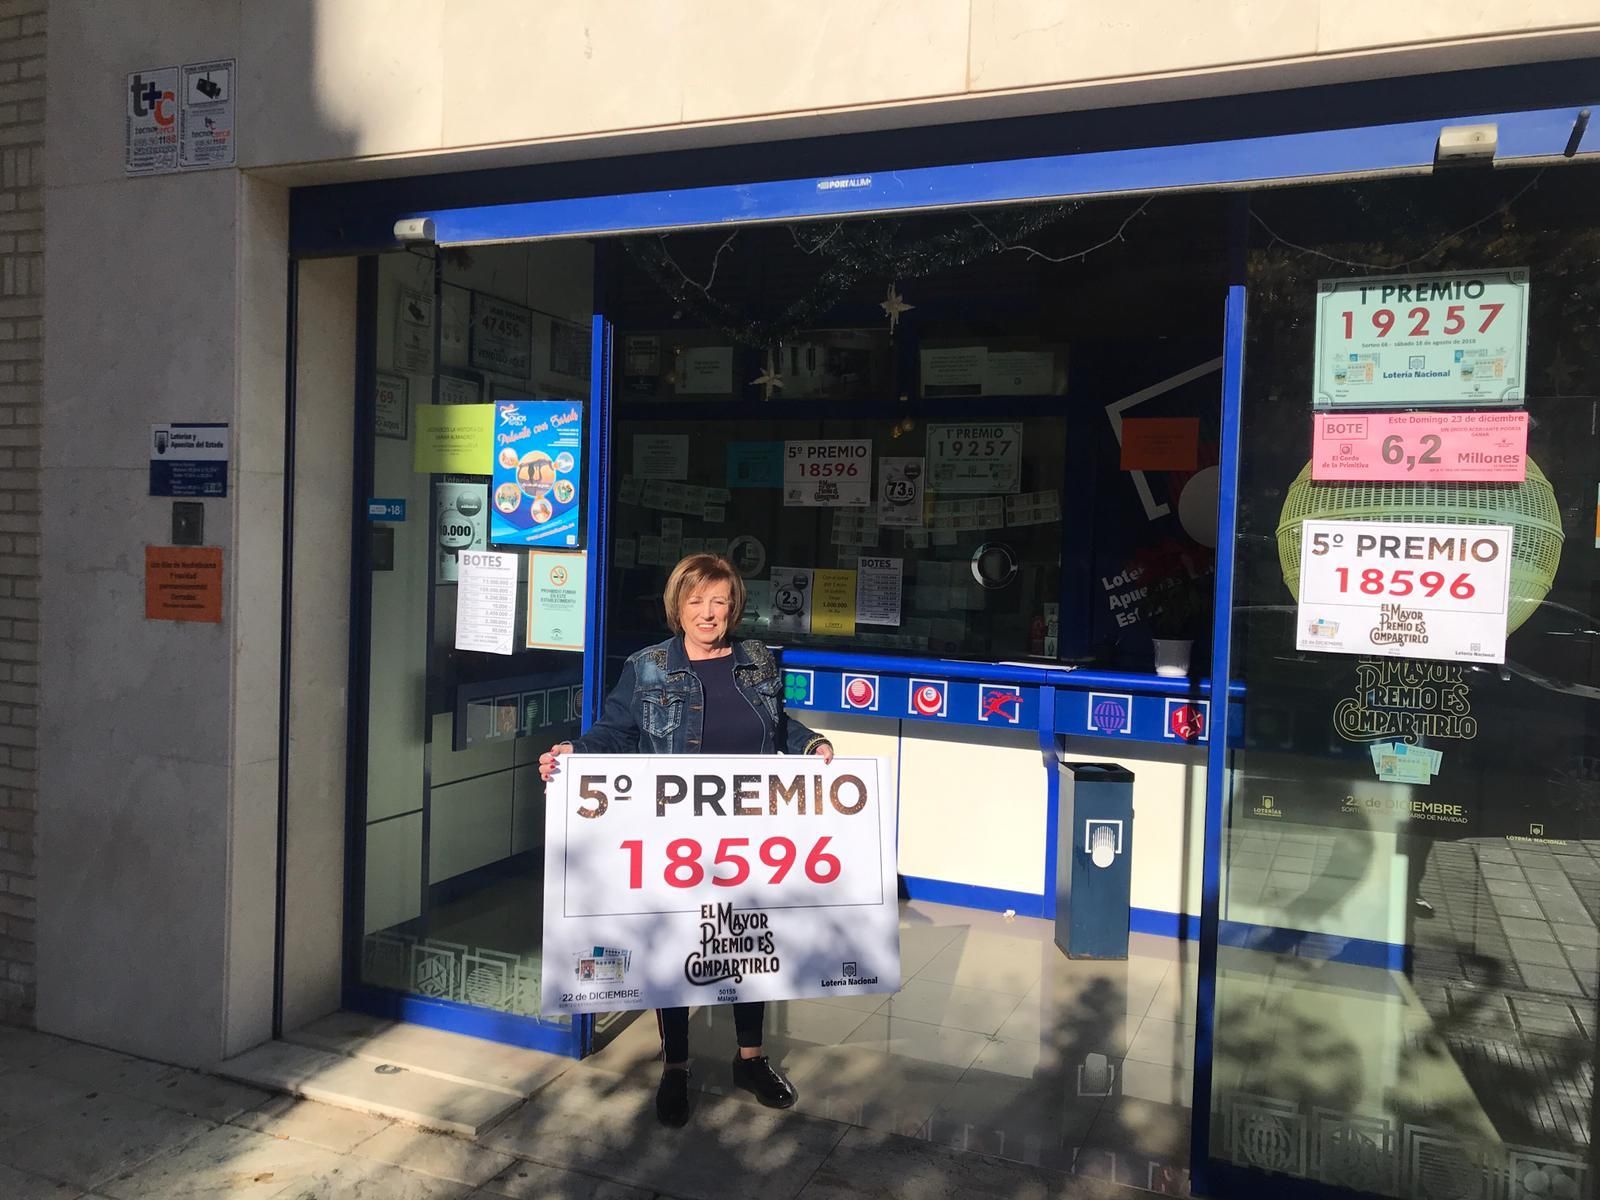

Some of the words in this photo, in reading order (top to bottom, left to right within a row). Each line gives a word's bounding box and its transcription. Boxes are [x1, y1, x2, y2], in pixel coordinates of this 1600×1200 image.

[1381, 279, 1484, 304] PREMIO
[1341, 303, 1505, 339] 19257
[1414, 370, 1450, 378] Nacional
[1326, 423, 1363, 434] BOTE
[1388, 416, 1408, 424] Este
[1409, 416, 1449, 425] Domingo
[1464, 415, 1476, 423] de
[1477, 414, 1524, 423] diciembre
[957, 428, 1004, 438] PREMIO
[788, 446, 803, 459] 5º
[807, 445, 867, 458] PREMIO
[937, 440, 1012, 457] 19257
[1381, 434, 1442, 472] 6,2
[1457, 452, 1520, 464] Millones
[799, 463, 858, 477] 18596
[1310, 533, 1343, 555] 5º
[1356, 534, 1499, 562] PREMIO
[463, 555, 502, 568] BOTES
[861, 559, 892, 568] BOTES
[1335, 567, 1475, 599] 18596
[1380, 603, 1390, 612] EL
[1390, 603, 1423, 622] MAYOR
[1379, 613, 1412, 631] PREMIO
[1369, 627, 1428, 647] COMPARTIRLO
[1355, 664, 1438, 710] PREMIO
[1333, 698, 1477, 745] COMPARTIRLO
[576, 774, 632, 819] 5º
[655, 774, 868, 817] PREMIO
[1436, 814, 1468, 824] NAVIDAD
[619, 836, 842, 889] 18596
[701, 904, 716, 919] EL
[717, 902, 768, 936] MAYOR
[700, 922, 754, 958] PREMIO
[684, 952, 780, 986] COMPARTIRLO
[821, 979, 847, 988] Lotería
[848, 976, 878, 986] Nacional
[561, 993, 573, 1002] 22
[575, 992, 587, 1001] de
[589, 989, 640, 1000] DICIEMBRE
